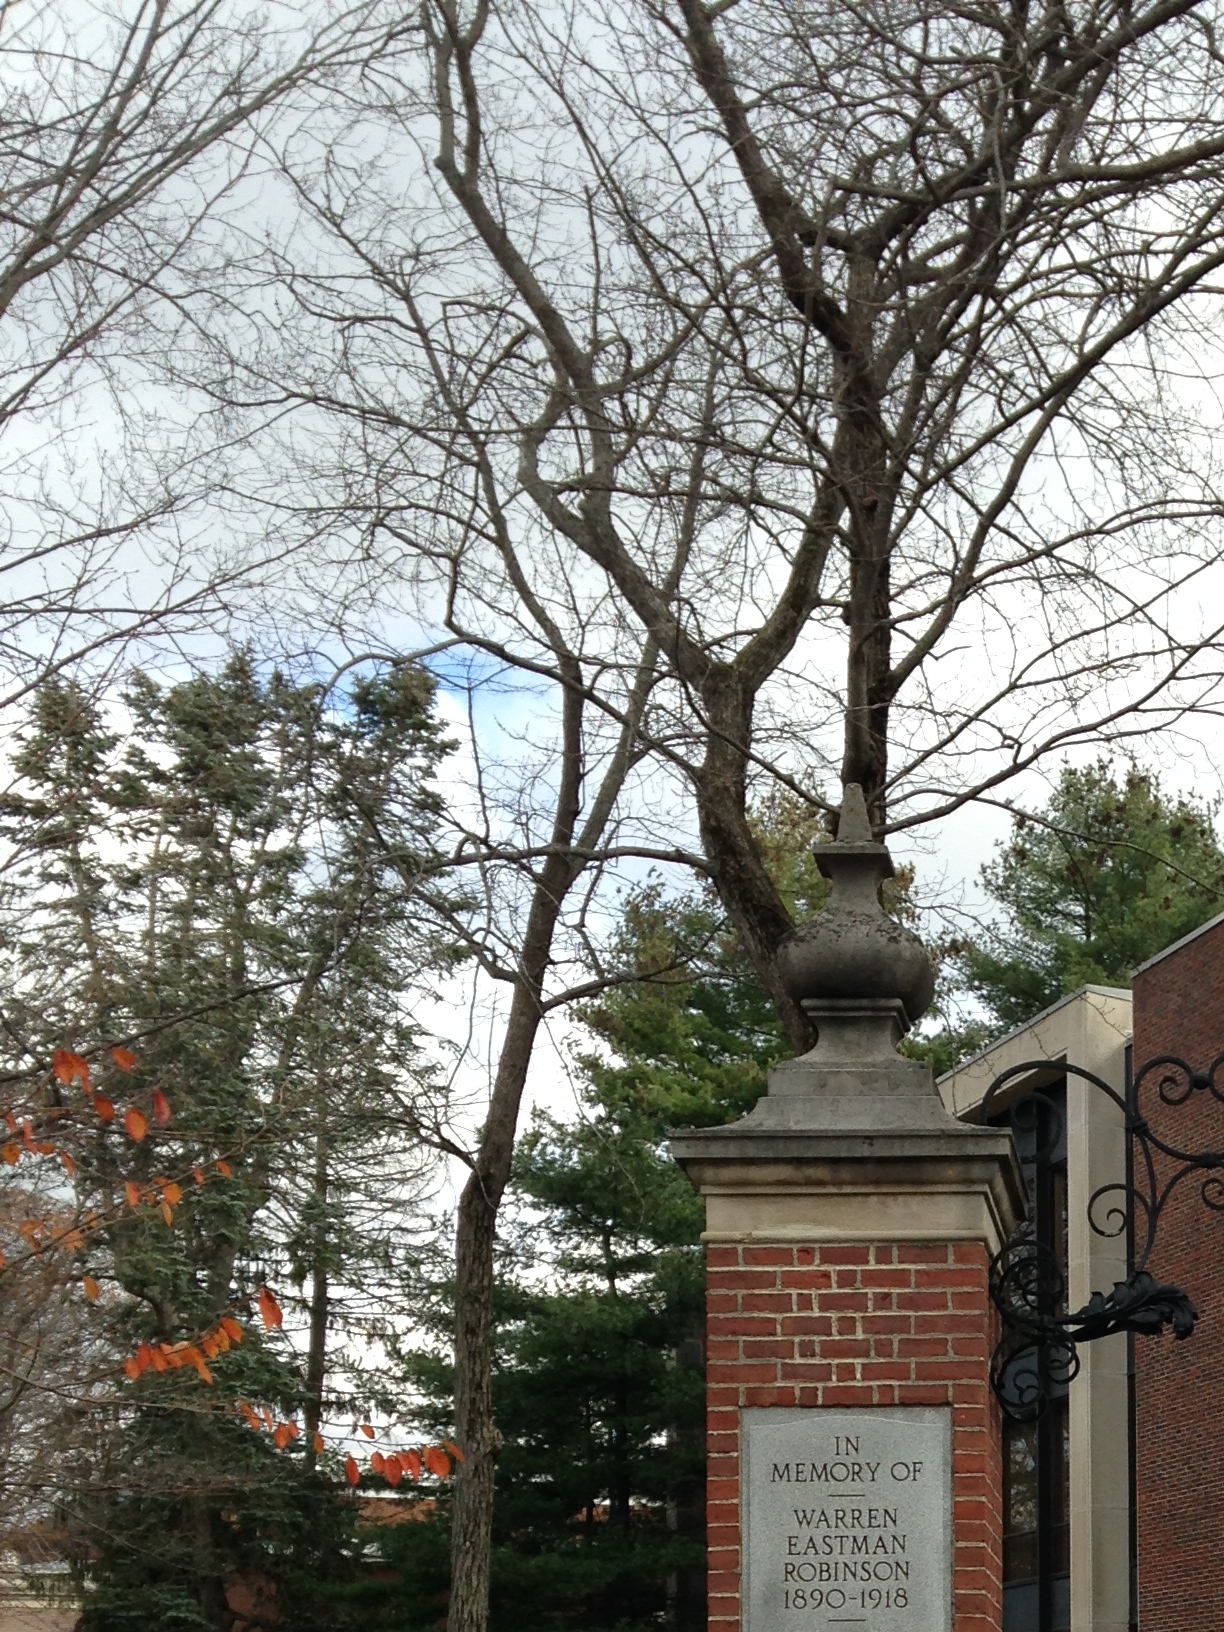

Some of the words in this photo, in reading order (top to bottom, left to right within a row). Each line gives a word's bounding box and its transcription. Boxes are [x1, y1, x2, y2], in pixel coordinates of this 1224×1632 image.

[834, 1436, 860, 1455] IN
[770, 1463, 880, 1483] MEMORY
[890, 1461, 923, 1481] OF
[794, 1508, 898, 1528] WARREN
[786, 1535, 906, 1555] EASTMAN
[784, 1561, 910, 1582] ROBINSON
[784, 1588, 908, 1609] 1890-1918
